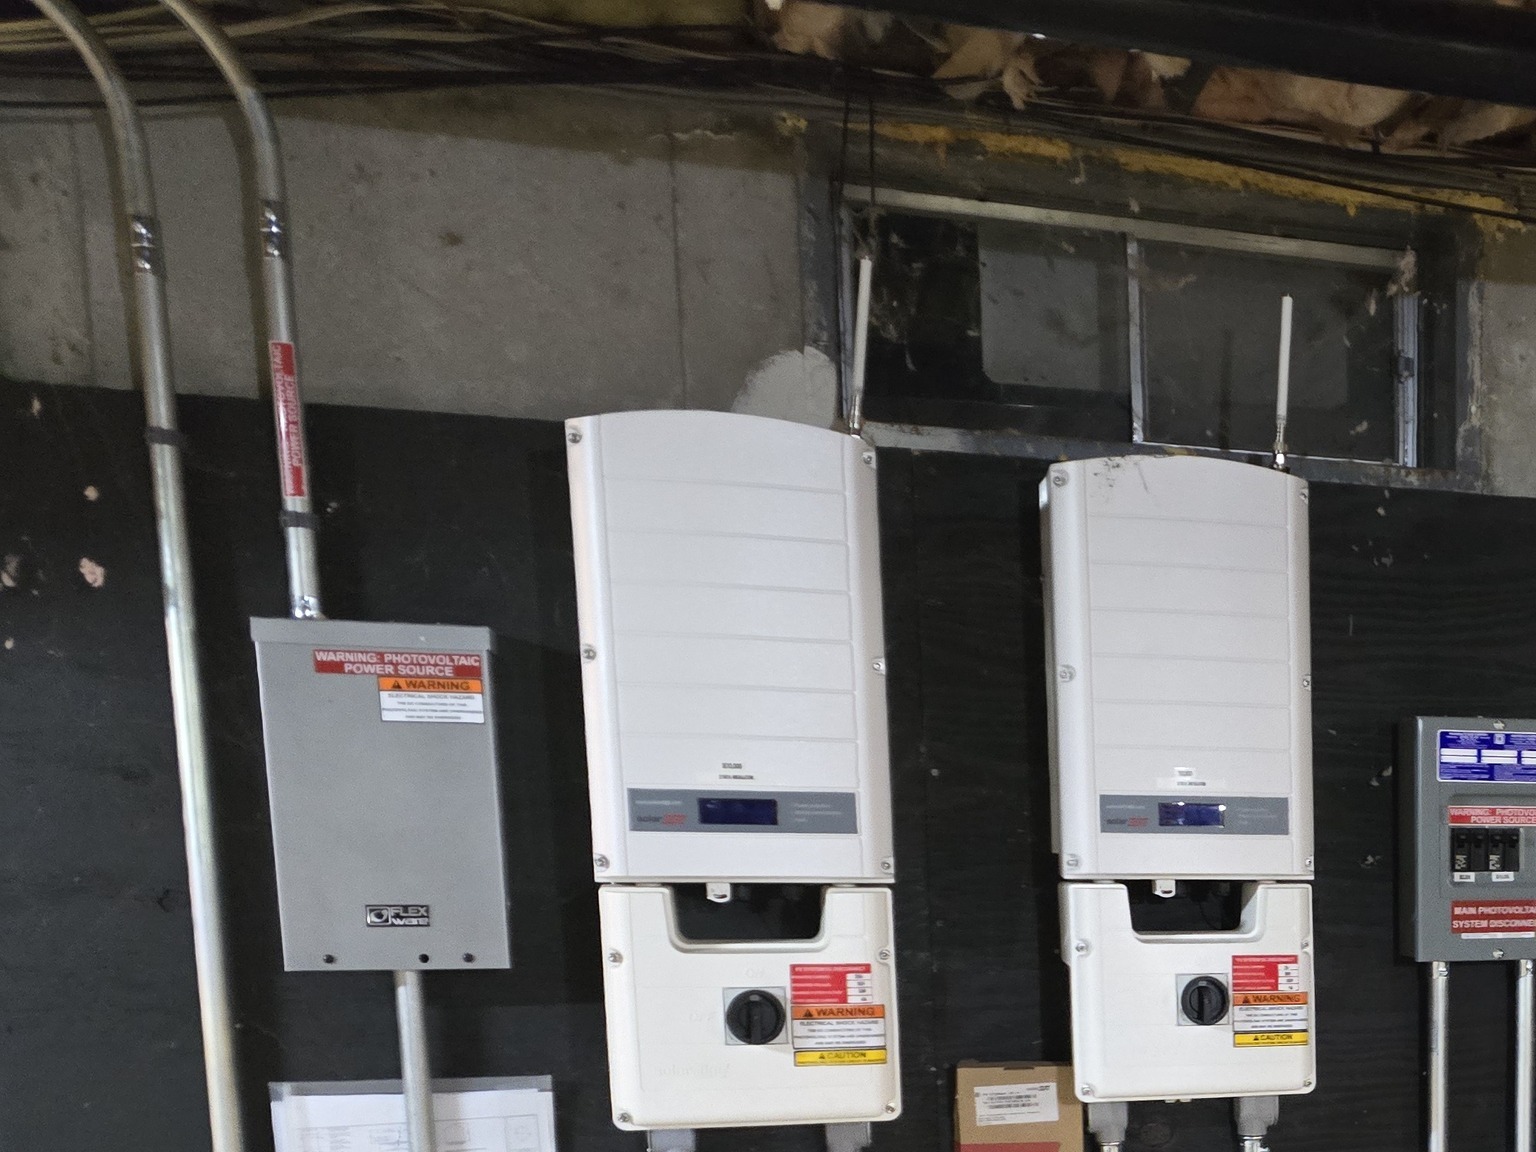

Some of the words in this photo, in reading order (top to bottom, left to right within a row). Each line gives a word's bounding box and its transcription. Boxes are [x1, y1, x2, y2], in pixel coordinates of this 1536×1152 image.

[284, 374, 299, 422] SOURCE
[288, 424, 302, 466] POWER
[315, 651, 380, 663] WARNING:
[384, 653, 480, 666] PHOTOVOLTAIC
[344, 663, 395, 675] POWER
[397, 664, 454, 676] SOURCE
[405, 680, 471, 691] WARNING
[390, 906, 428, 916] FLEX
[1454, 906, 1477, 914] MAIN
[1452, 920, 1489, 928] SYSTEM
[1253, 994, 1301, 1003] WARNING
[816, 1007, 875, 1017] WARNING
[826, 1051, 867, 1059] CAUTION
